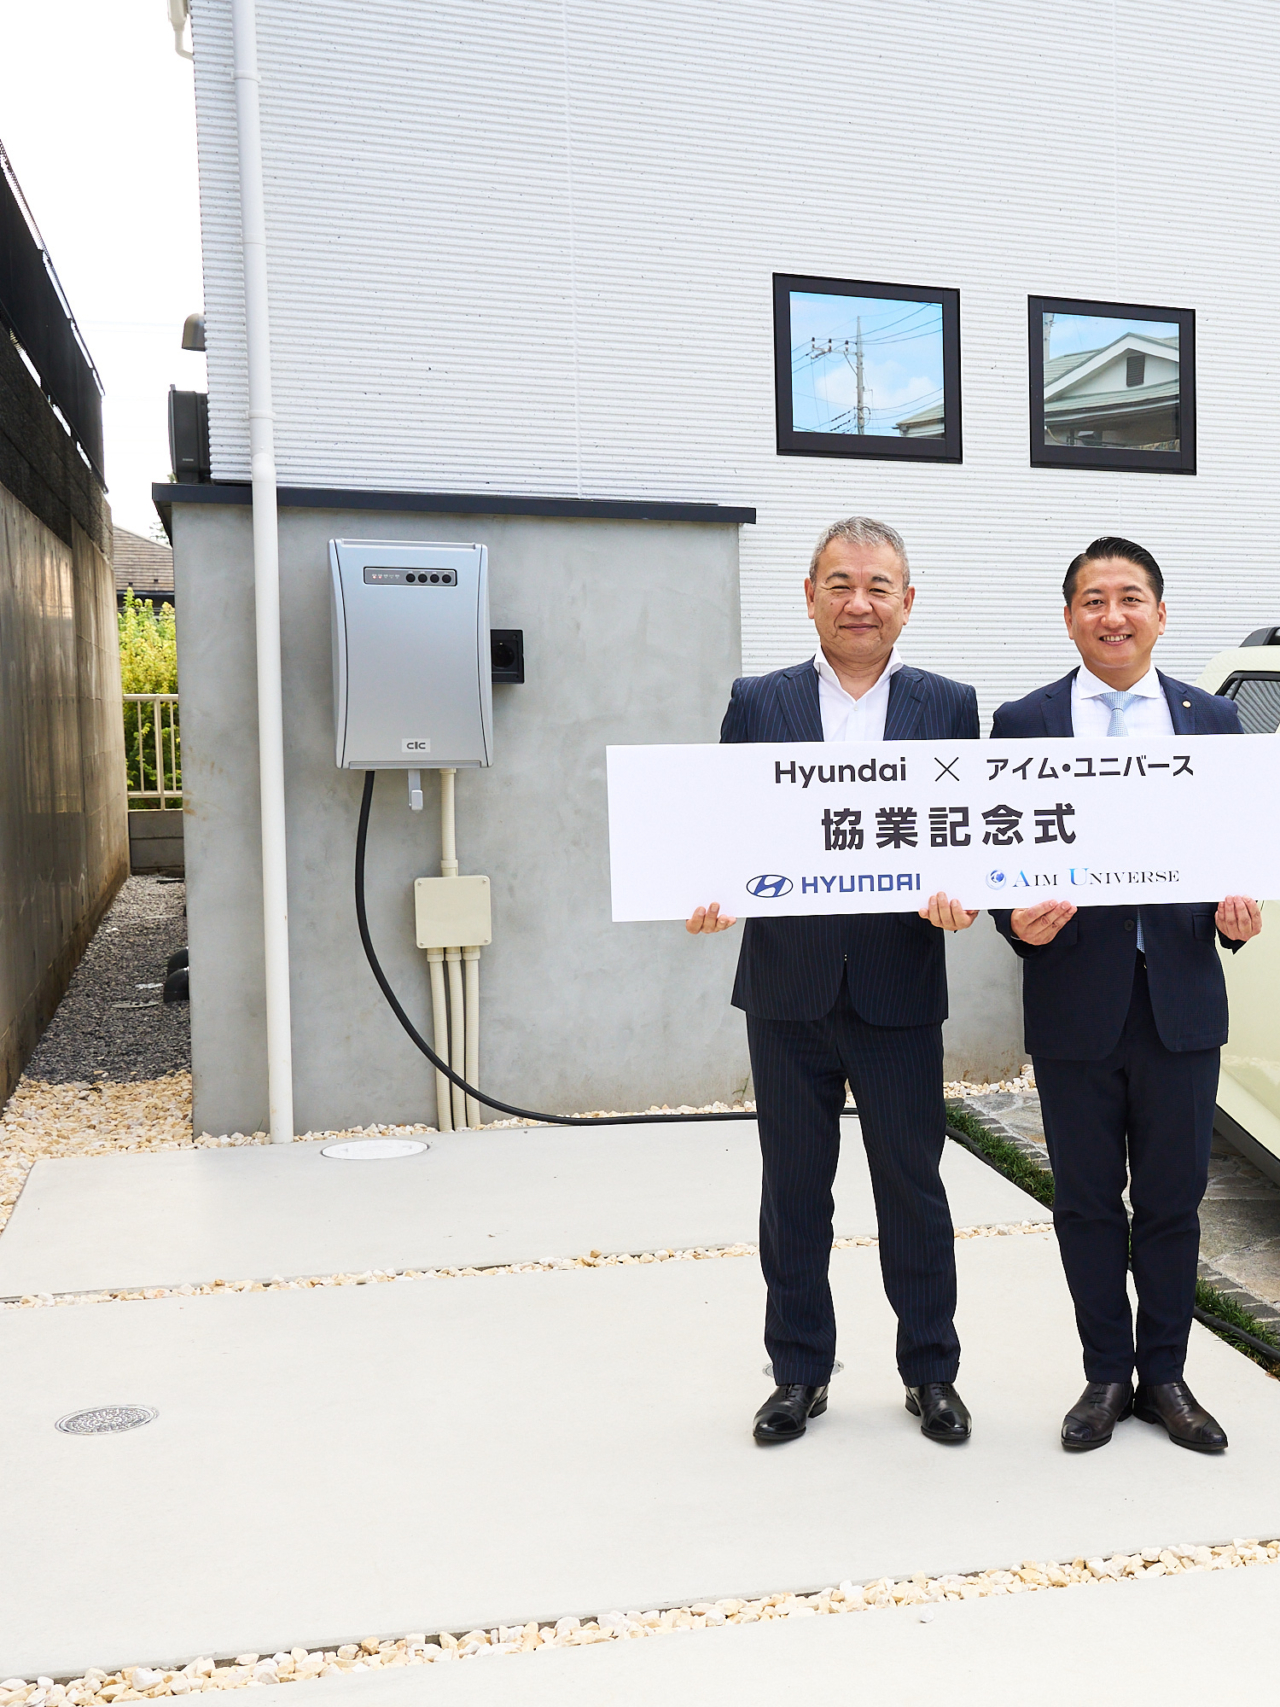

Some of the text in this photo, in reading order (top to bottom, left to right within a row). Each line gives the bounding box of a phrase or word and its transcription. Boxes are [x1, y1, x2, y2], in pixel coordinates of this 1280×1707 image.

[774, 756, 907, 788] Hyundai
[986, 754, 1194, 781] アイム・ユニバース
[820, 802, 1077, 851] 協業記念式
[801, 873, 921, 895] HYUNDAI
[1068, 867, 1180, 886] UNIVERSE
